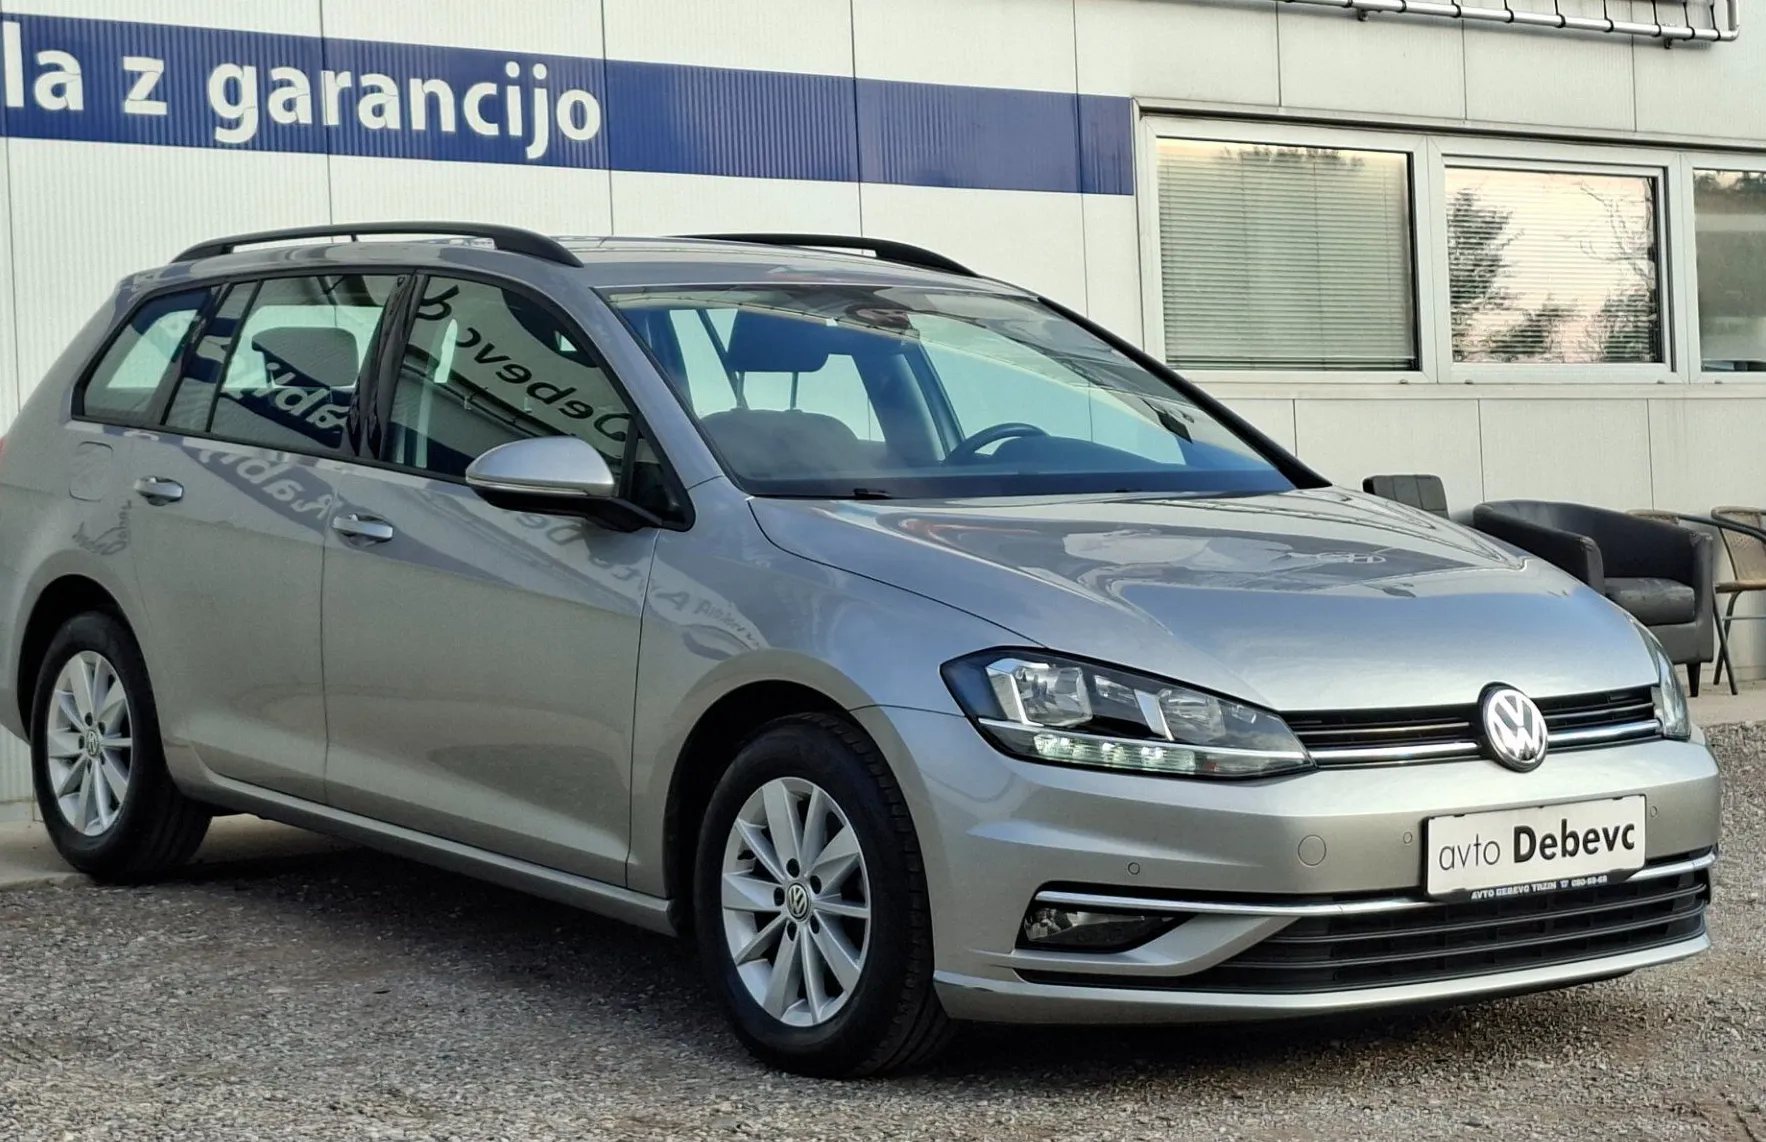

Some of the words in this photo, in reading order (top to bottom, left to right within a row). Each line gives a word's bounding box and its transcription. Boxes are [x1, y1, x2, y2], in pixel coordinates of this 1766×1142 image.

[1, 21, 84, 111] la
[122, 55, 168, 116] z
[207, 60, 602, 160] garancijo
[1438, 833, 1501, 871] avto
[1513, 818, 1636, 864] Debevc
[1471, 889, 1495, 900] AVTO
